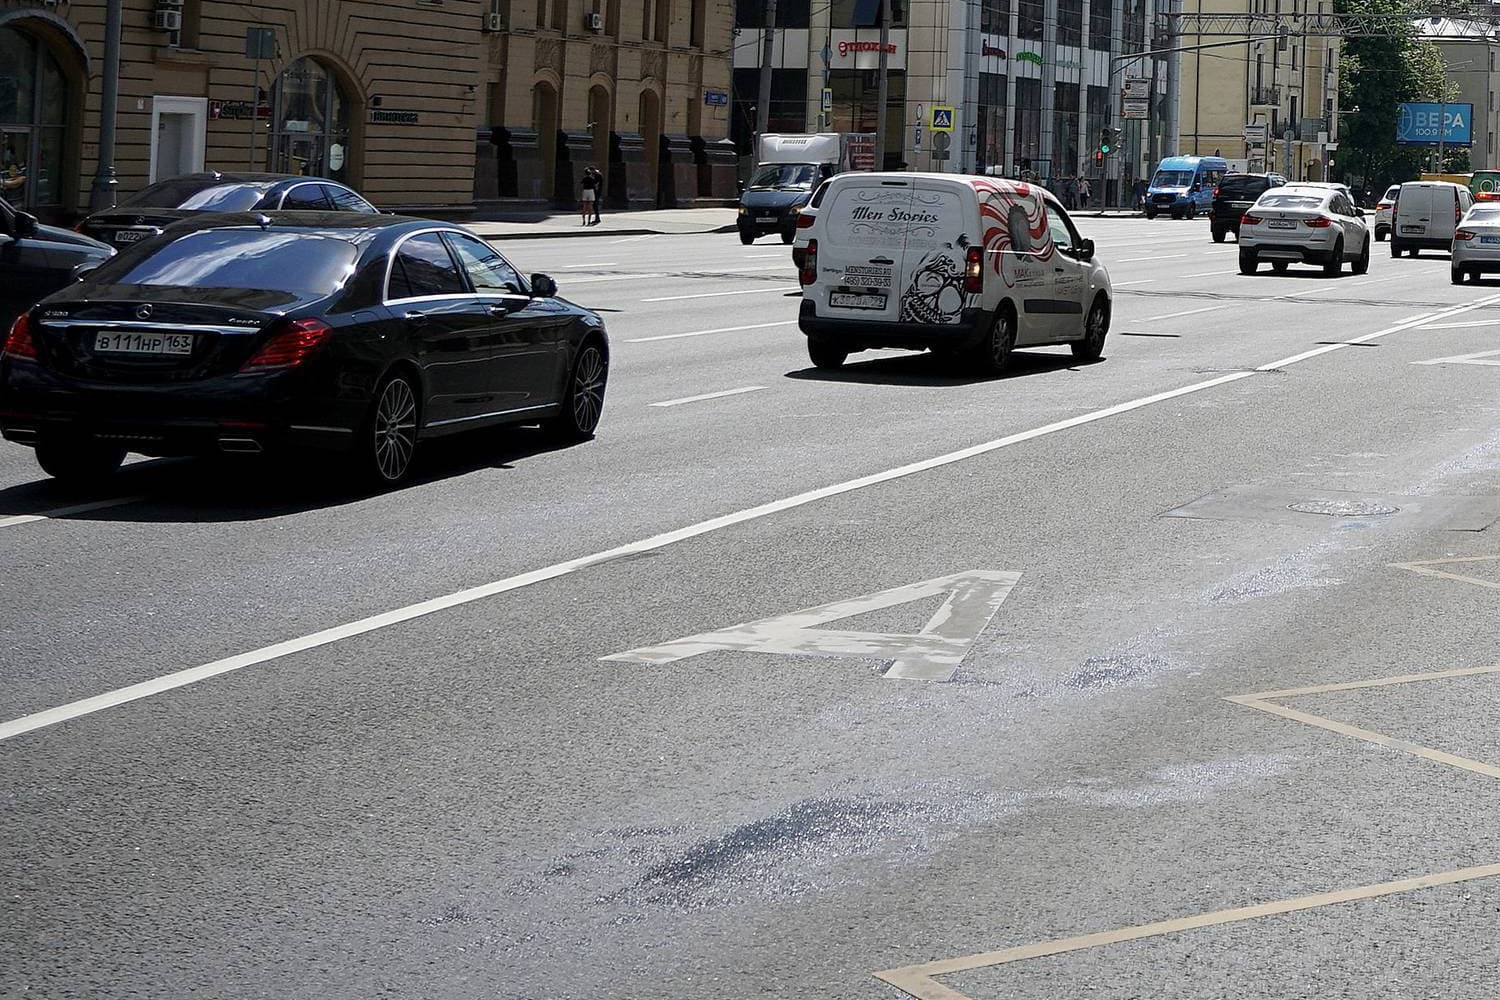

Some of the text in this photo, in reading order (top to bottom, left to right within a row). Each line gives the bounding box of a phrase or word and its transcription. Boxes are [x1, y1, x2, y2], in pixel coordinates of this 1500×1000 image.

[1416, 112, 1464, 127] ВЕРА
[852, 207, 938, 222] Men Stories
